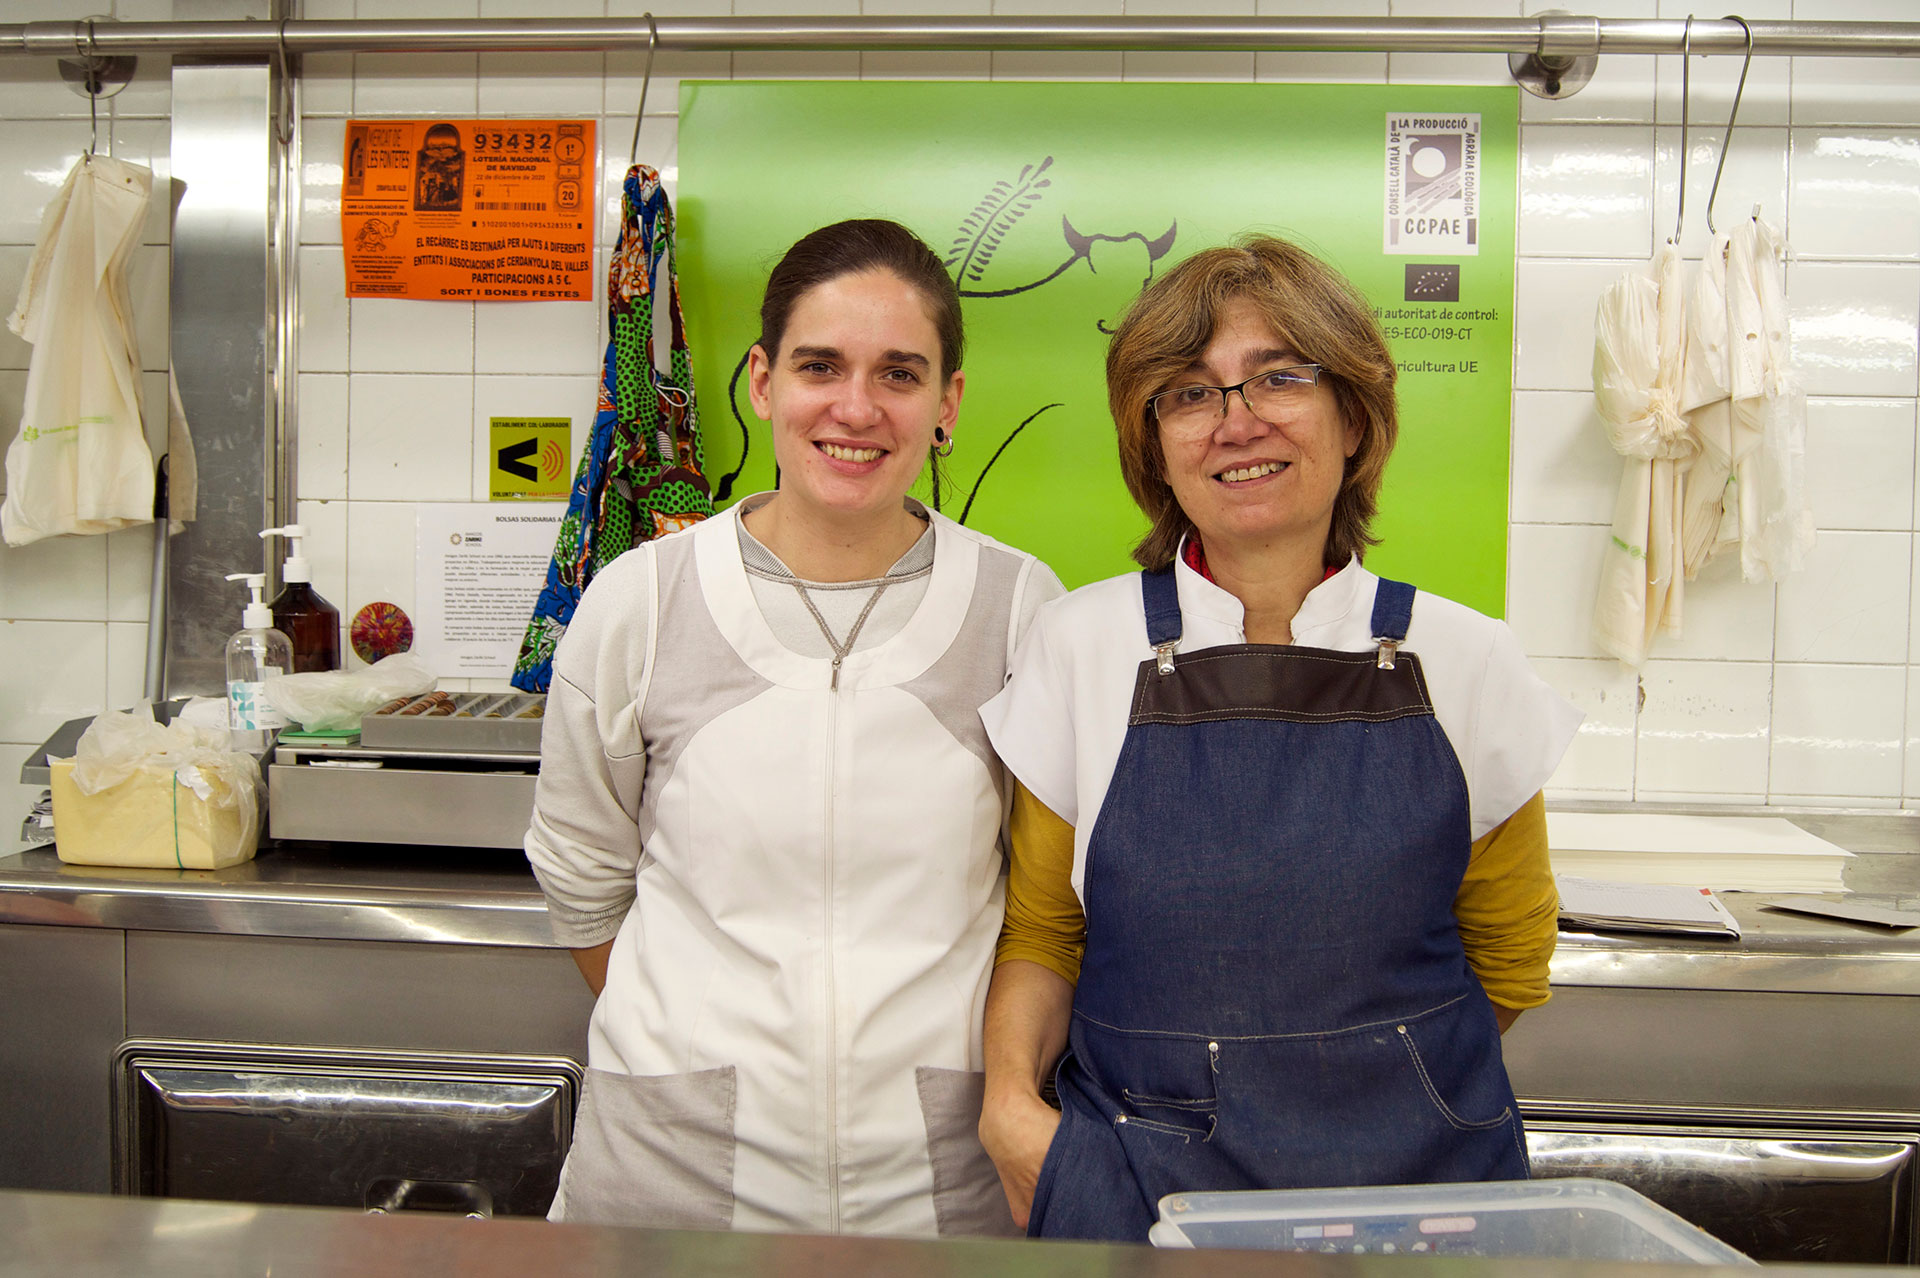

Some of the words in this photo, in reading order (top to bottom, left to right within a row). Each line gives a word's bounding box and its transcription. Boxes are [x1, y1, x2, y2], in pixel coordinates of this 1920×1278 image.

[1399, 118, 1410, 129] LA
[1413, 117, 1468, 130] PRODUCCIÓ
[475, 133, 552, 150] 93432
[1390, 131, 1401, 143] DE
[1464, 132, 1477, 170] AGRÀRIA
[473, 155, 508, 164] LOTERÍA
[509, 156, 551, 164] NACIONAL
[1388, 146, 1401, 178] CATALÀ
[562, 191, 575, 201] 20
[1388, 179, 1400, 215] CONSELL
[1463, 171, 1476, 216] ECOLÒGICA
[1405, 218, 1461, 235] CCPAE
[416, 237, 425, 248] EL
[460, 239, 469, 251] ES
[507, 238, 521, 249] PER
[521, 238, 543, 250] AJUTS
[543, 241, 549, 251] A
[550, 241, 586, 254] DIFERENTS
[413, 255, 444, 267] ENTITATS
[449, 256, 495, 270] ASSOCIACIONS
[496, 257, 506, 269] DE
[506, 256, 550, 270] CERDANYOLA
[551, 260, 564, 272] DEL
[471, 272, 545, 285] PARTICIPACIONS
[546, 274, 554, 286] A
[556, 274, 562, 286] 5
[440, 288, 473, 296] SORT
[476, 288, 481, 296] I
[484, 289, 529, 297] BONES
[531, 290, 580, 298] FESTES
[1384, 307, 1437, 320] autoritat
[1439, 308, 1453, 321] de
[1455, 308, 1499, 321] control:
[1396, 360, 1456, 373] ricultura
[1459, 361, 1479, 374] UE
